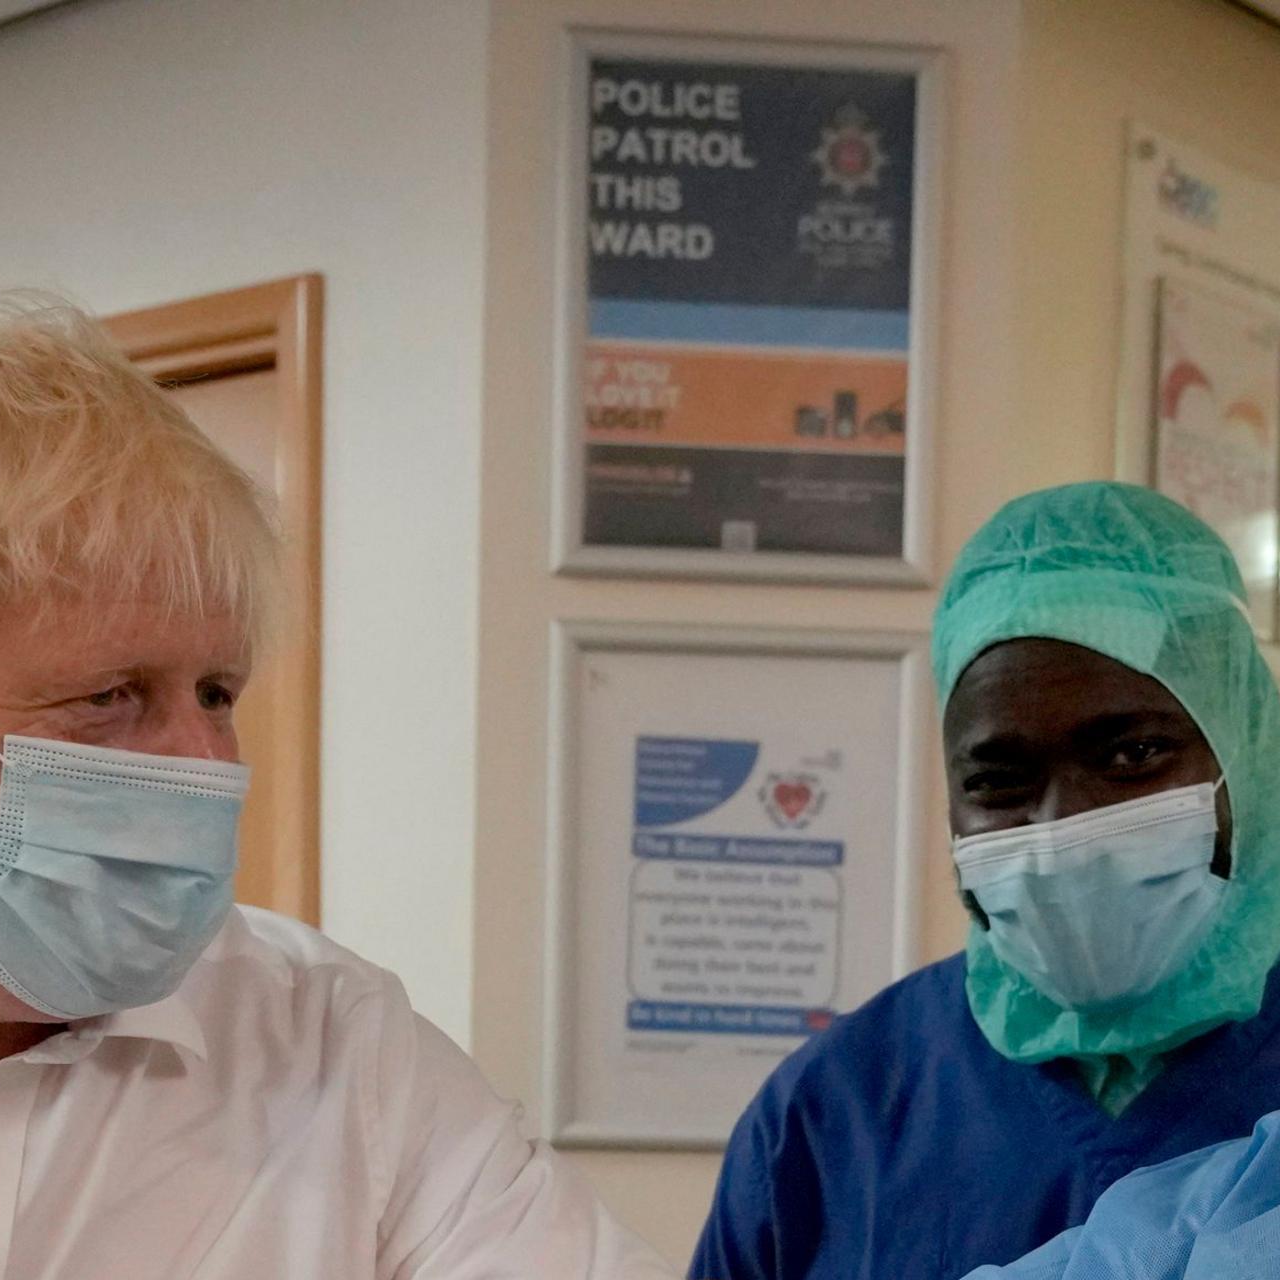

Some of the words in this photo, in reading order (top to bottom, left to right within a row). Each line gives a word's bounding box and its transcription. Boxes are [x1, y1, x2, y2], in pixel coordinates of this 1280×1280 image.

[592, 78, 742, 121] POLICE
[592, 126, 757, 169] PATROL
[591, 173, 682, 212] THIS
[590, 221, 715, 260] WARD
[614, 361, 671, 384] YOU
[585, 384, 652, 408] LOVE
[586, 406, 639, 431] LOG
[642, 408, 665, 433] IT
[636, 834, 669, 854] The
